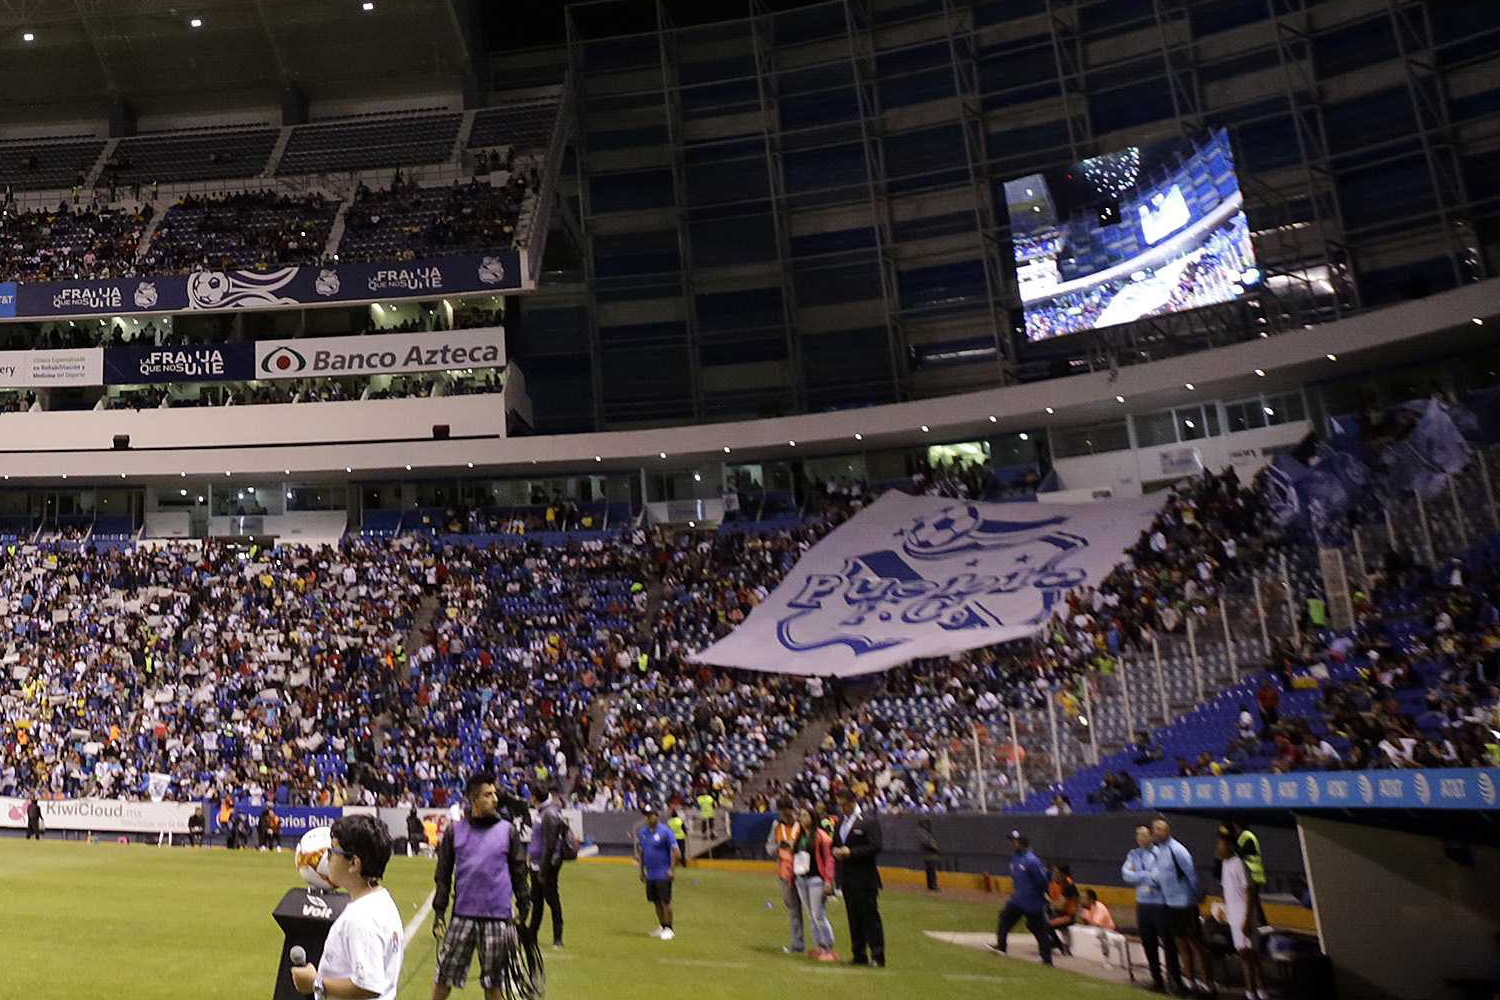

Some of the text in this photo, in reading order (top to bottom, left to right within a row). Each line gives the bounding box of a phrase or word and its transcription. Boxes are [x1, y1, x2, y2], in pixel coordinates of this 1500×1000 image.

[313, 344, 499, 371] Banco Azteca
[308, 814, 336, 828] Ruiz
